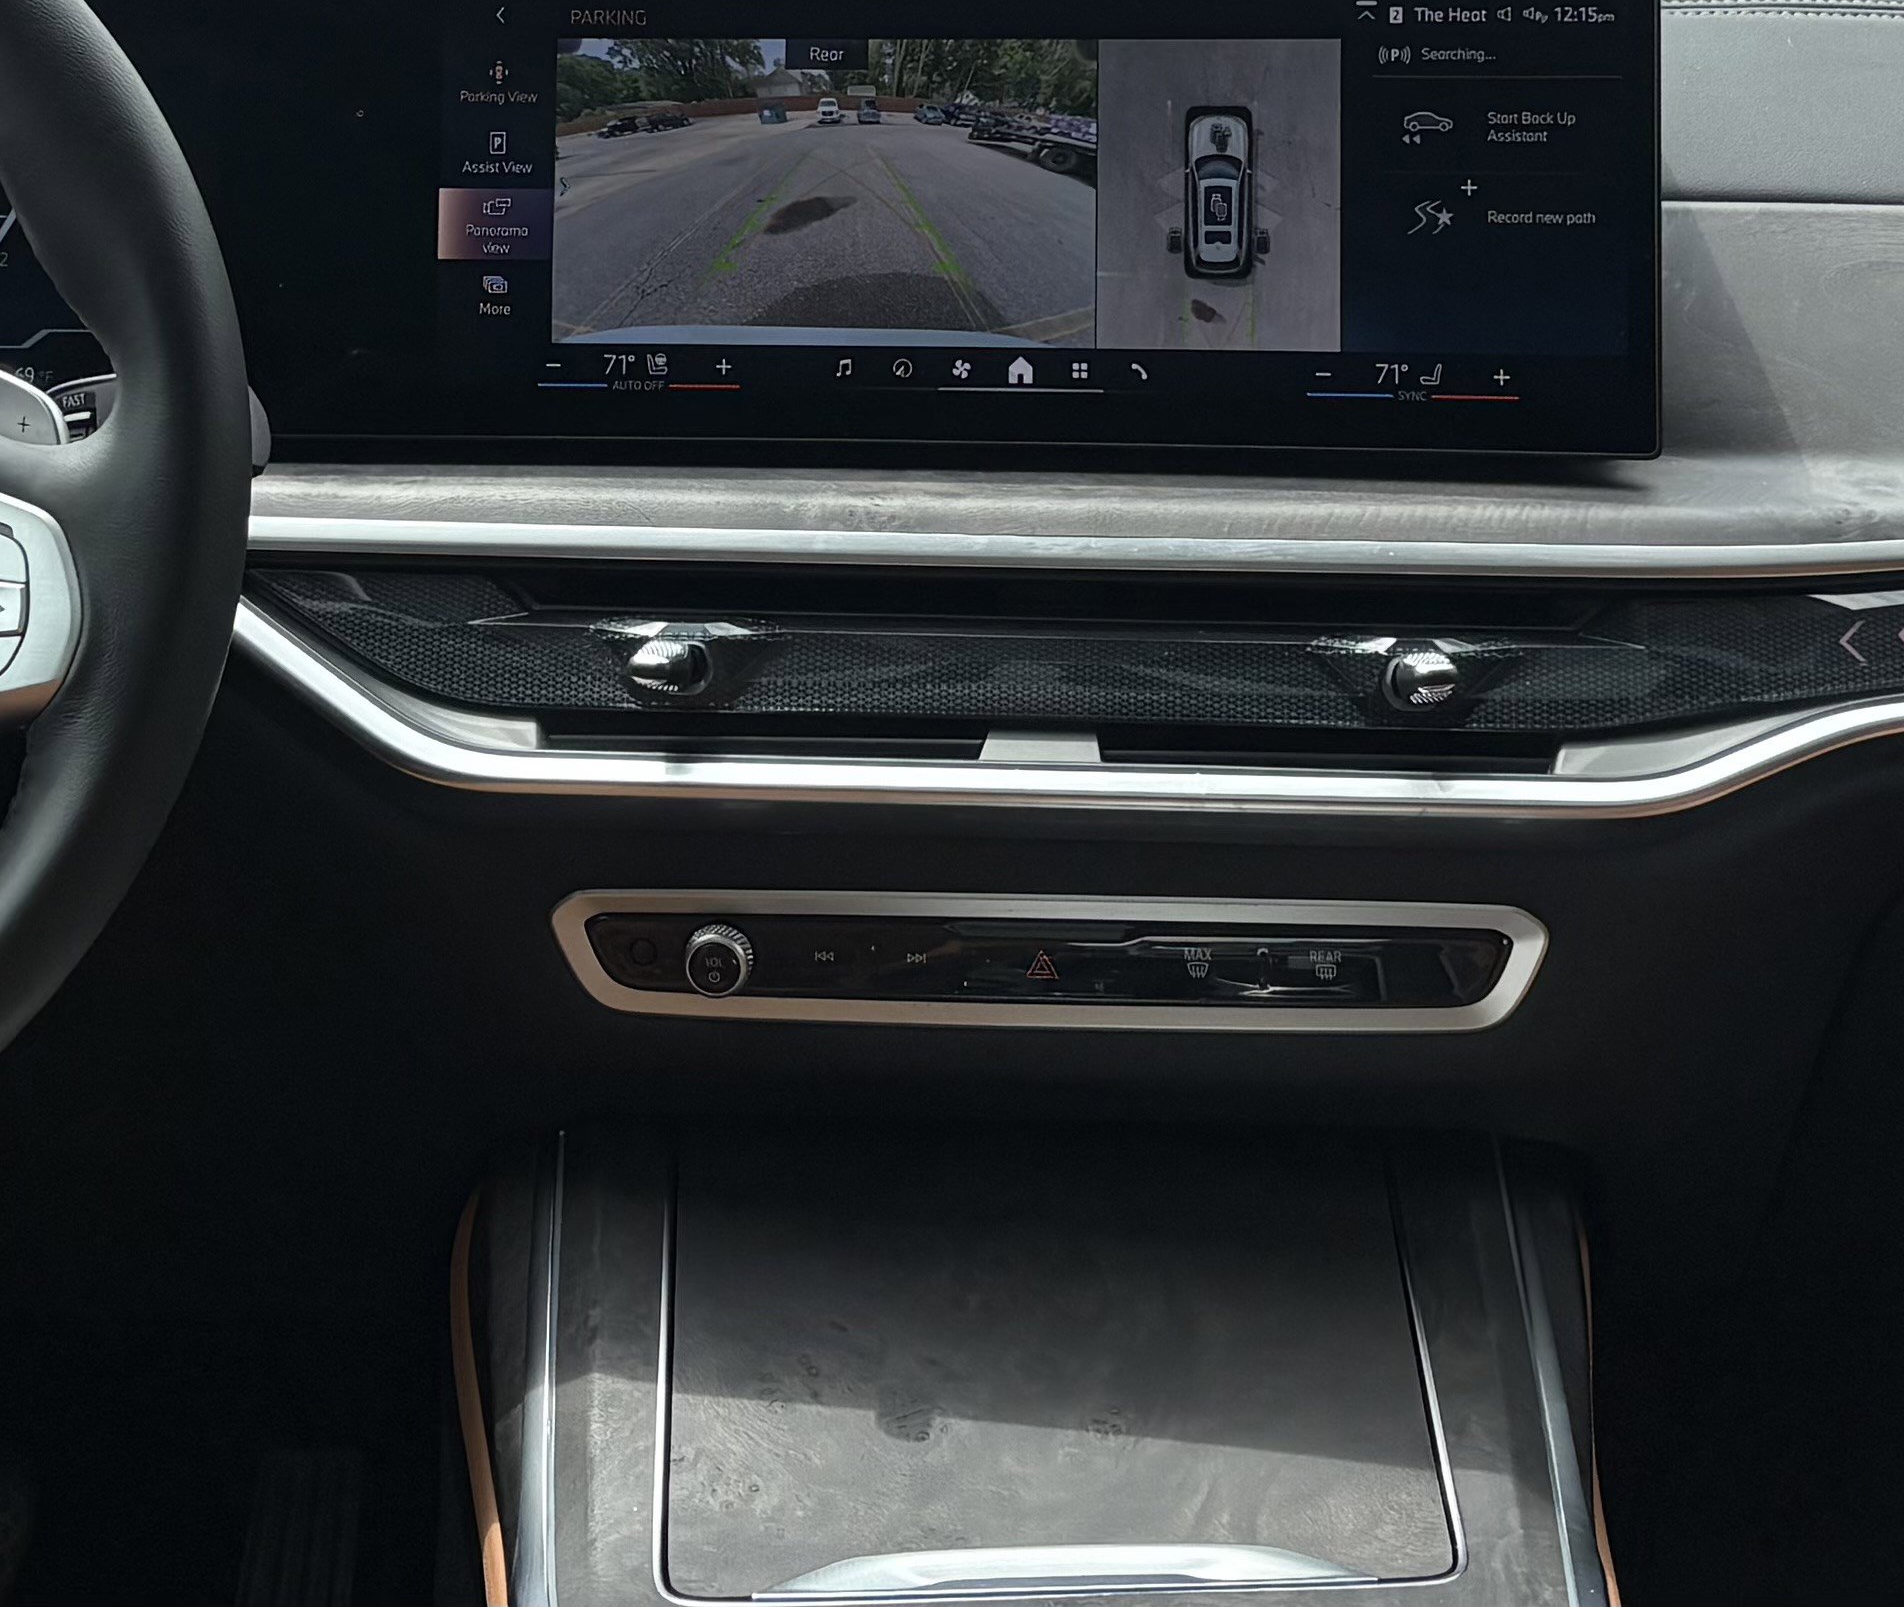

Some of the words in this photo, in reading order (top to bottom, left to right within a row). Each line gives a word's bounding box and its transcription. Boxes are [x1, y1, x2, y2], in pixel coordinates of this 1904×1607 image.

[570, 9, 647, 26] PARKING
[1413, 7, 1444, 22] The
[1449, 7, 1487, 22] Heat
[809, 46, 844, 63] Rear
[1421, 48, 1497, 63] Searching...
[459, 90, 505, 106] Parking
[509, 90, 539, 103] View
[1487, 111, 1518, 125] Start
[1522, 111, 1554, 125] Back
[1557, 111, 1577, 127] Up
[1487, 130, 1548, 143] Assistant
[462, 161, 500, 174] Assist
[503, 161, 533, 174] View
[1487, 210, 1533, 224] Record
[1536, 213, 1564, 224] new
[1566, 211, 1596, 225] path
[465, 224, 529, 237] Panorama
[482, 242, 511, 254] view
[479, 302, 511, 316] More
[603, 354, 636, 375] 71°
[1375, 363, 1409, 385] 71°
[612, 380, 642, 392] AUTO
[644, 380, 665, 392] OFF
[62, 393, 86, 408] FAST
[1397, 390, 1428, 402] SYNC
[1183, 947, 1213, 961] MAX
[1309, 950, 1343, 963] REAR
